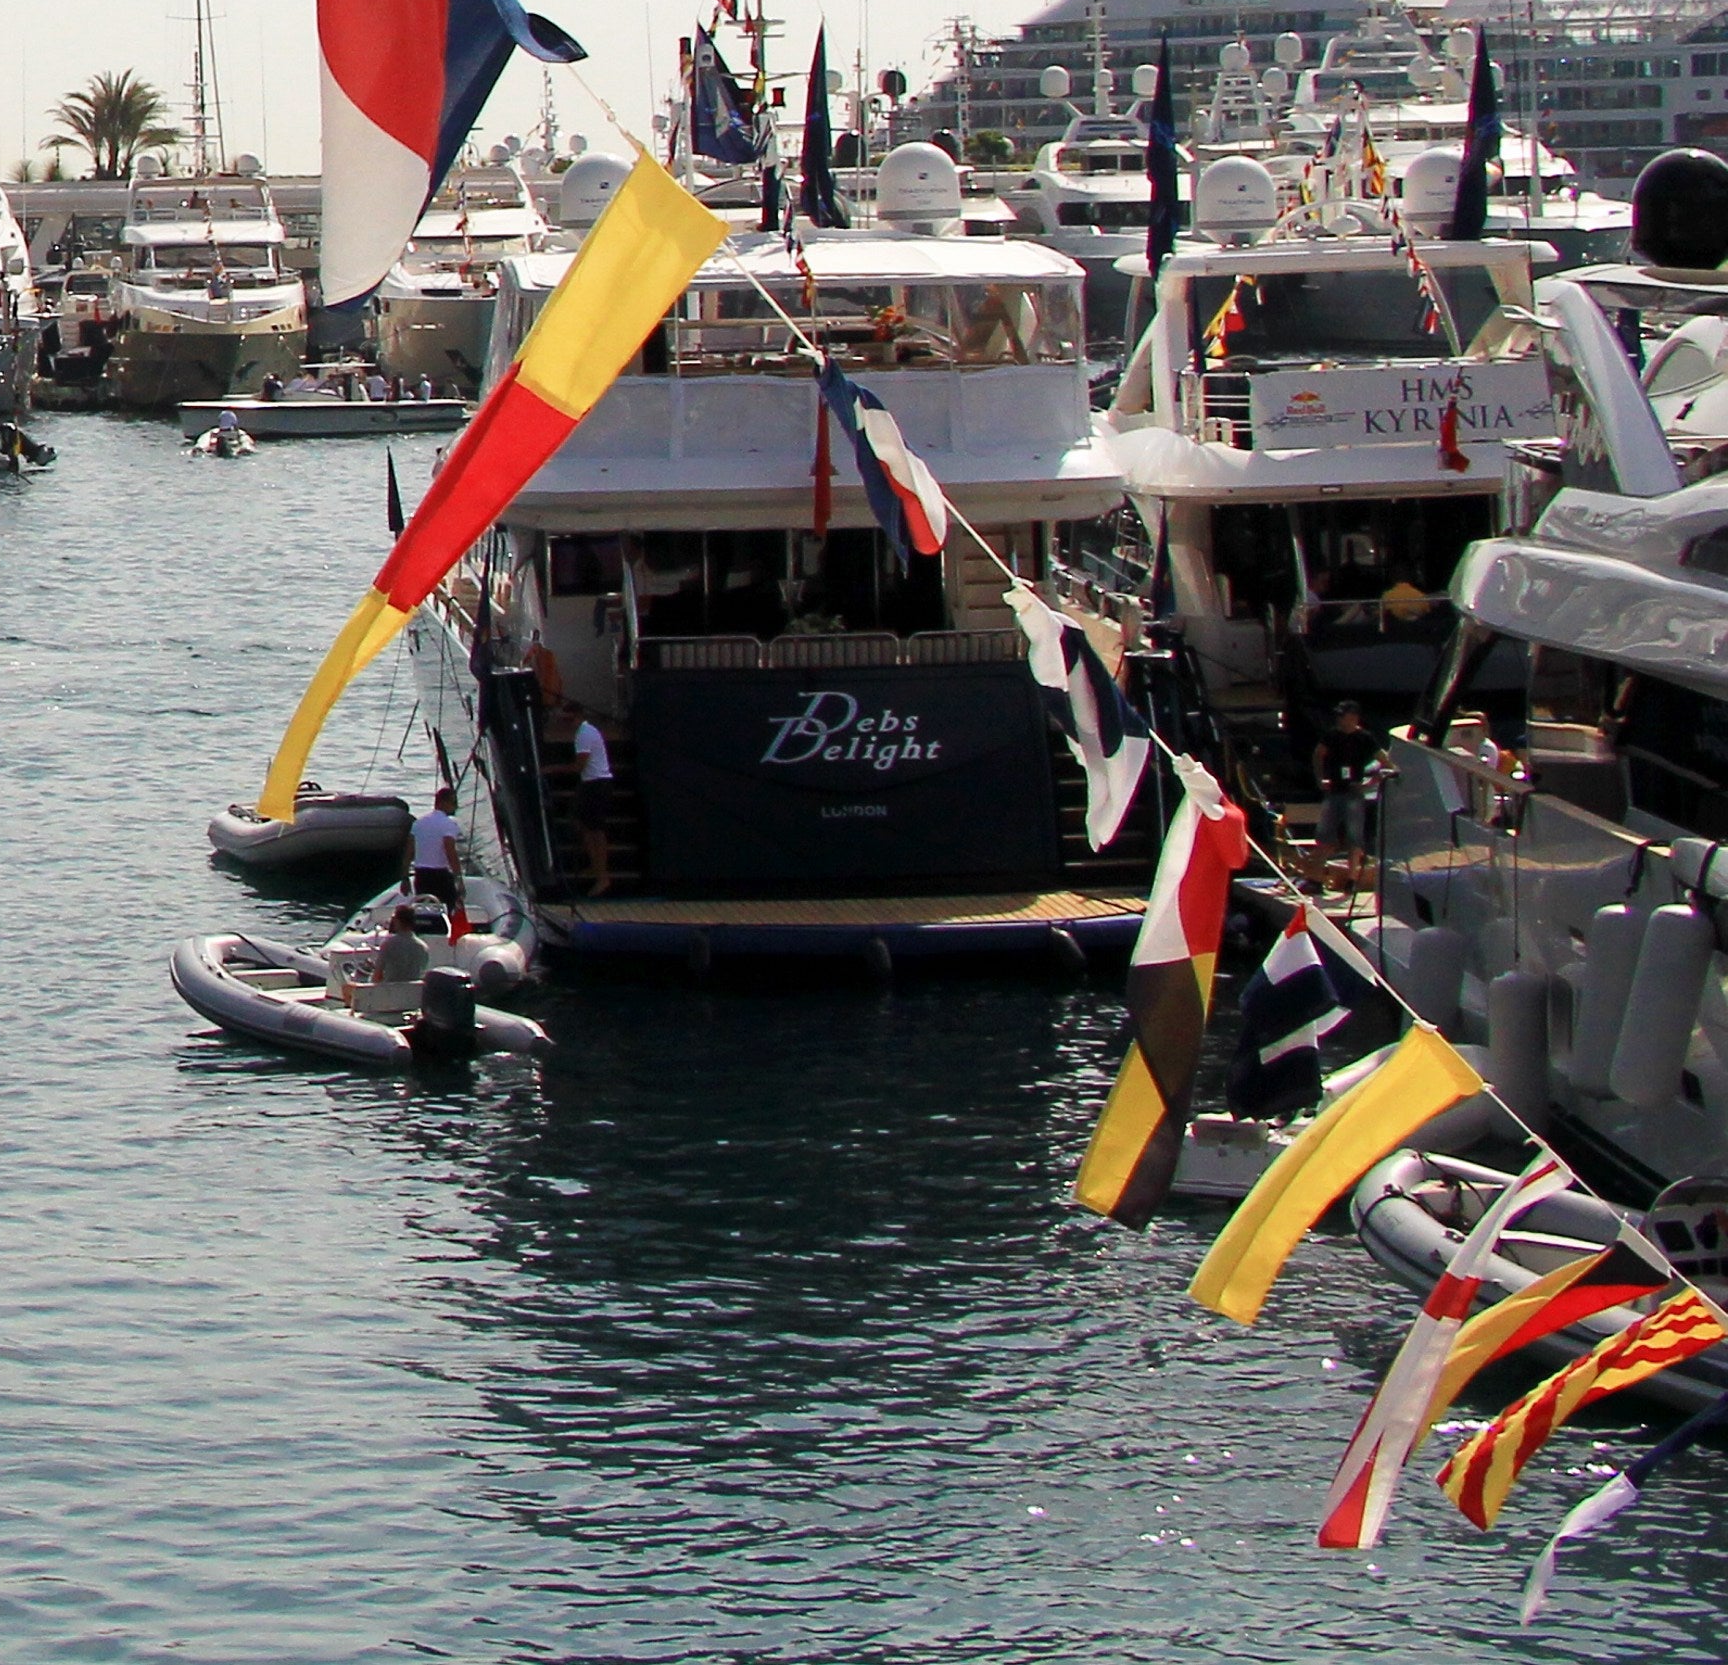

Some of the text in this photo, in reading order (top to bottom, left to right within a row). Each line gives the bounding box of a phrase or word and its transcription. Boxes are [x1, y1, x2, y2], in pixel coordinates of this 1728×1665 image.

[1401, 374, 1473, 403] HMS
[1364, 403, 1515, 434] KYRNIA
[797, 690, 920, 736] Debs
[760, 716, 943, 770] Delight
